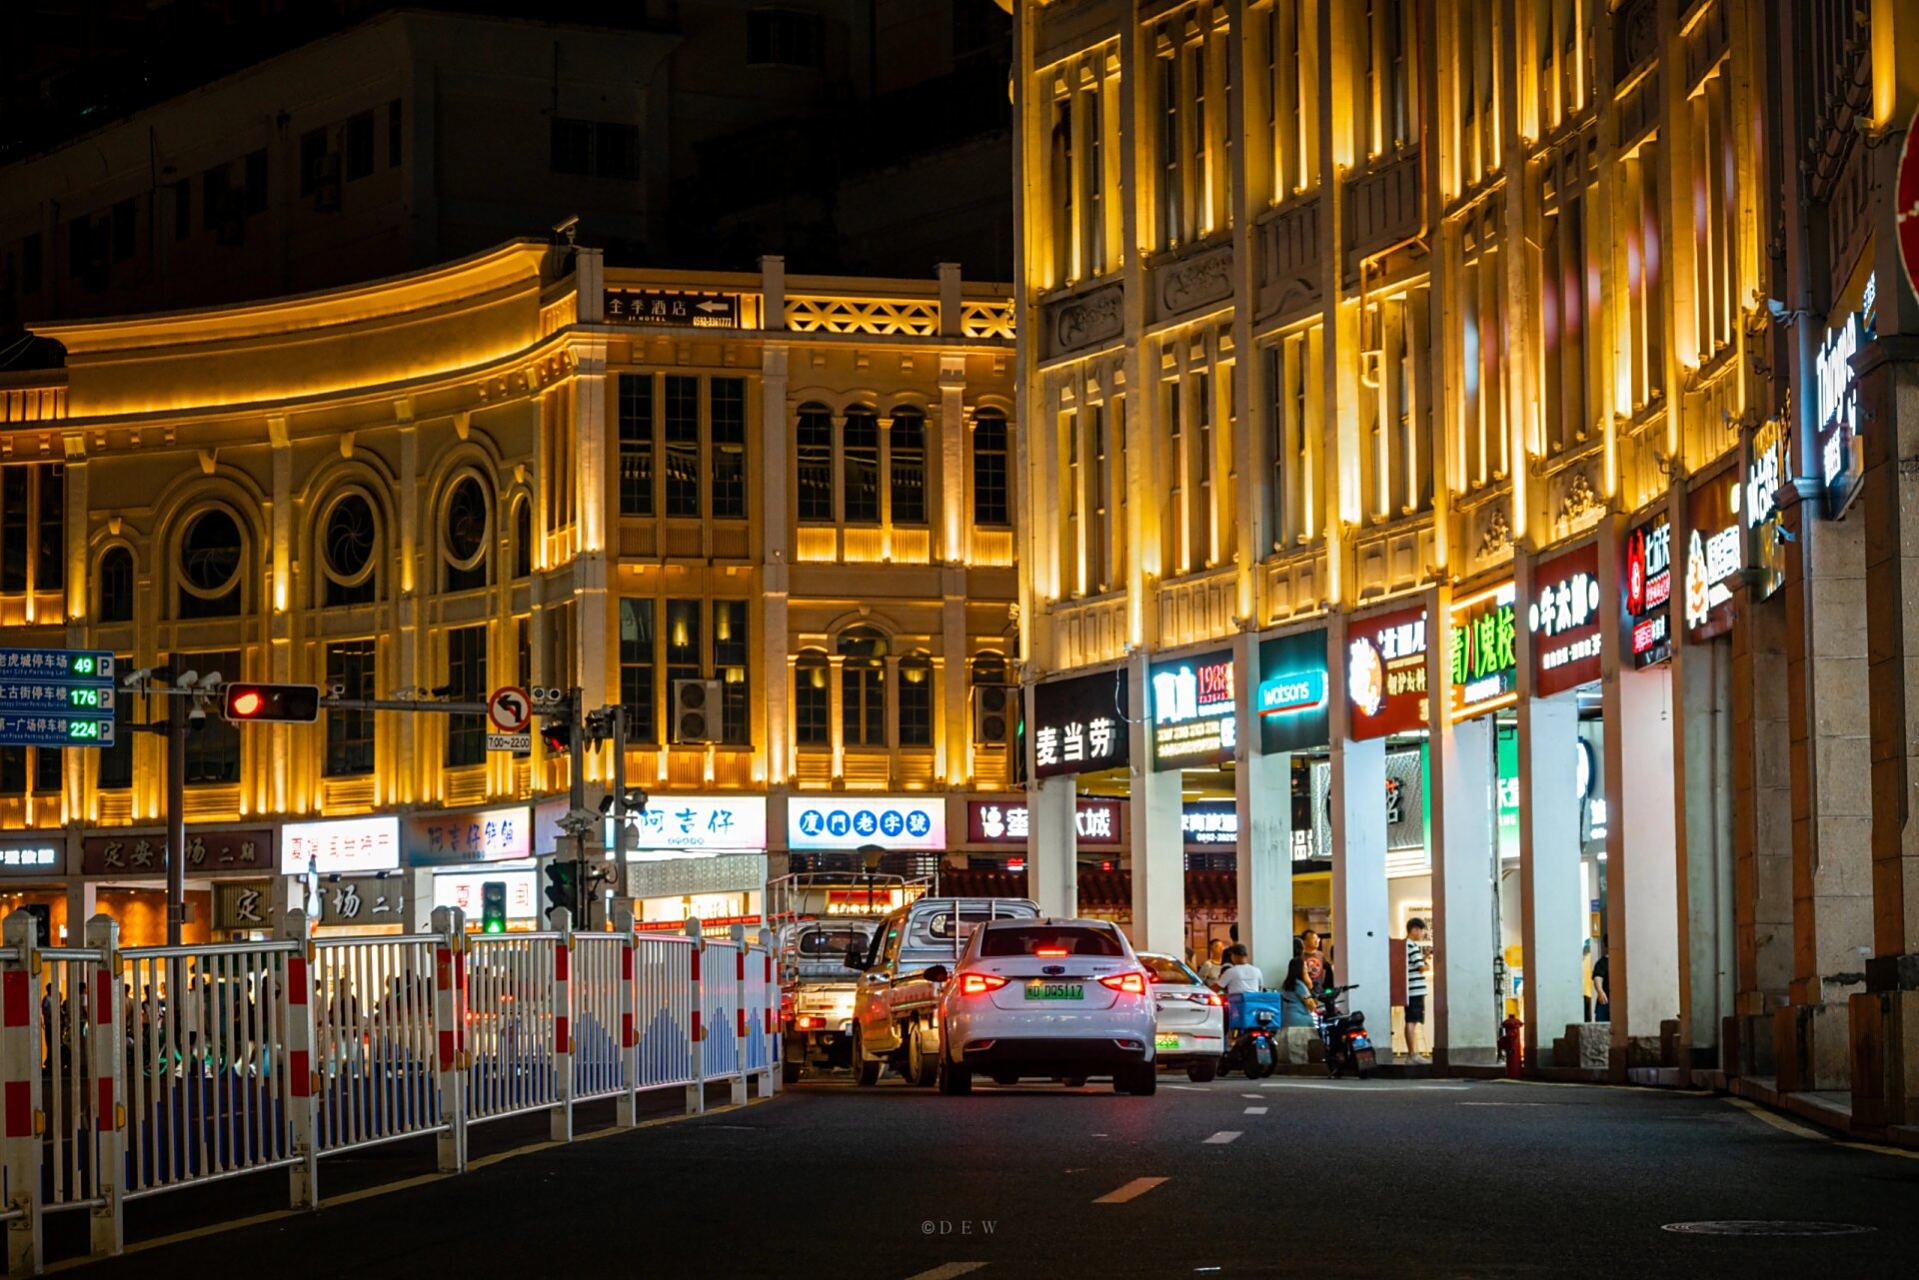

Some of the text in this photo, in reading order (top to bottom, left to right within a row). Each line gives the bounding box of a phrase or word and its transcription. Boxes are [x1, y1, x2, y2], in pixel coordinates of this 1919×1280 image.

[609, 299, 686, 316] 全季酒店
[75, 658, 92, 673] 49
[71, 690, 97, 705] 176
[71, 722, 97, 737] 224
[1037, 718, 1115, 767] 麦当劳
[640, 808, 734, 835] 阿吉仔
[104, 839, 255, 868] 定安场二期
